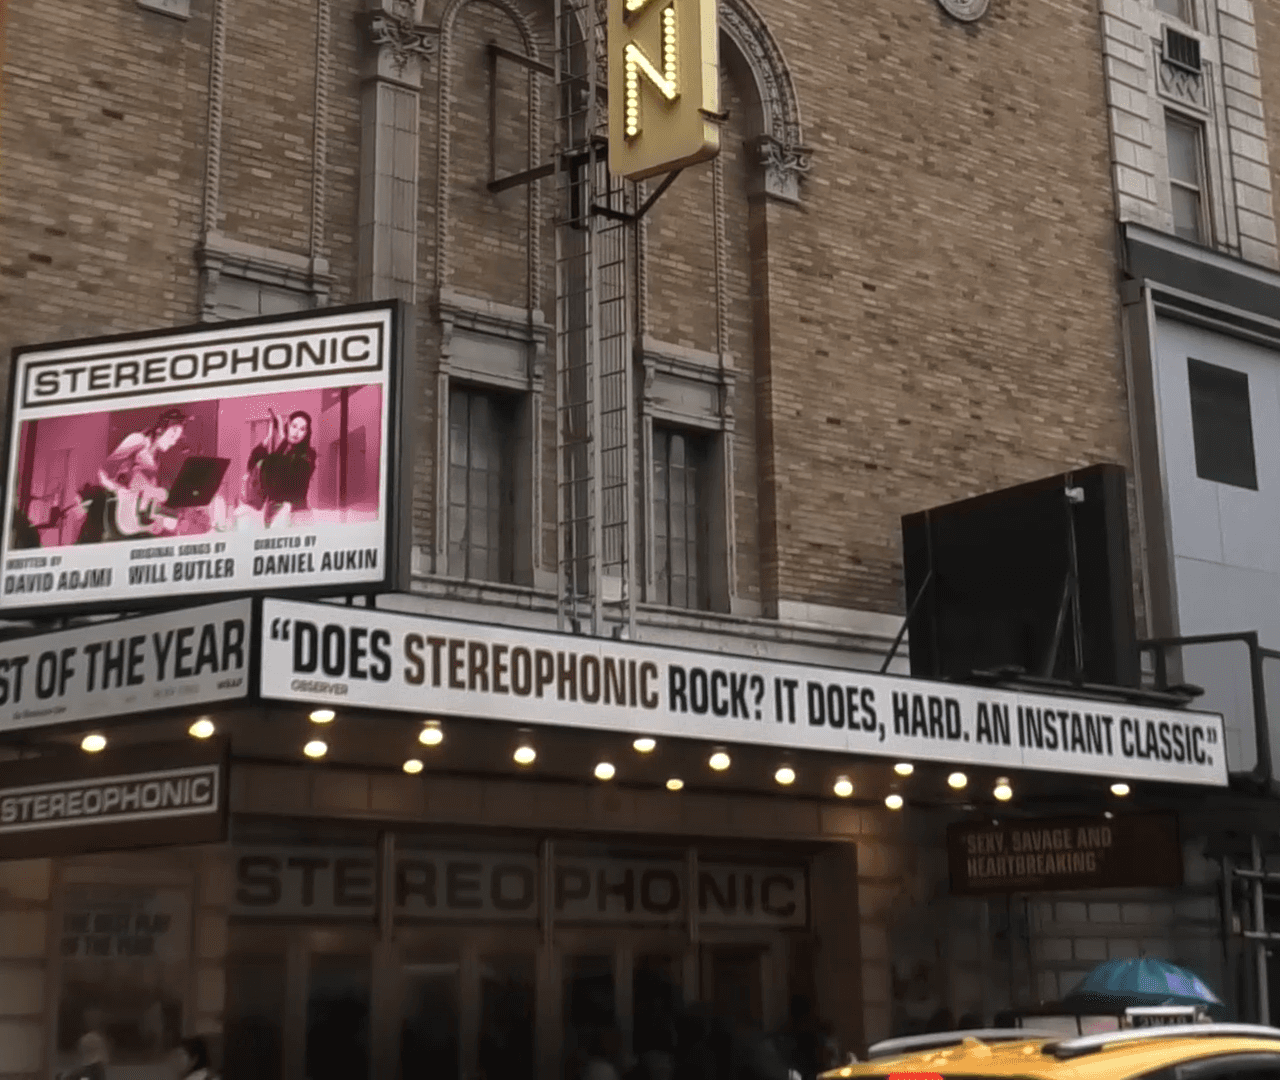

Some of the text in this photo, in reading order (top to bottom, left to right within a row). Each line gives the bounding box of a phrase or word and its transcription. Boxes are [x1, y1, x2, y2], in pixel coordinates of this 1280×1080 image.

[34, 335, 371, 396] STEREOPHONIC
[253, 535, 317, 551] DIRECTED BY
[128, 557, 235, 586] WILL BUTLER
[252, 548, 378, 576] DANIEL AUKIN
[4, 567, 113, 595] DAVID ADJMI
[34, 647, 77, 701] OF
[83, 633, 147, 692] THE
[152, 617, 246, 682] YEAR
[270, 617, 392, 683] “DOES
[403, 632, 659, 710] STEREOPHONIC
[668, 664, 764, 720] ROCK?
[775, 677, 798, 723] IT
[807, 682, 887, 742] DOES,
[891, 691, 970, 743] HARD.
[976, 700, 1011, 747] AN
[1018, 704, 1114, 756] INSTANT
[290, 679, 349, 696] OBSERVER
[0, 778, 212, 822] STEREOPHONIC
[1012, 828, 1072, 852] SAVAGE
[1077, 826, 1112, 848] AND
[235, 854, 796, 917] STEREOPHONIC
